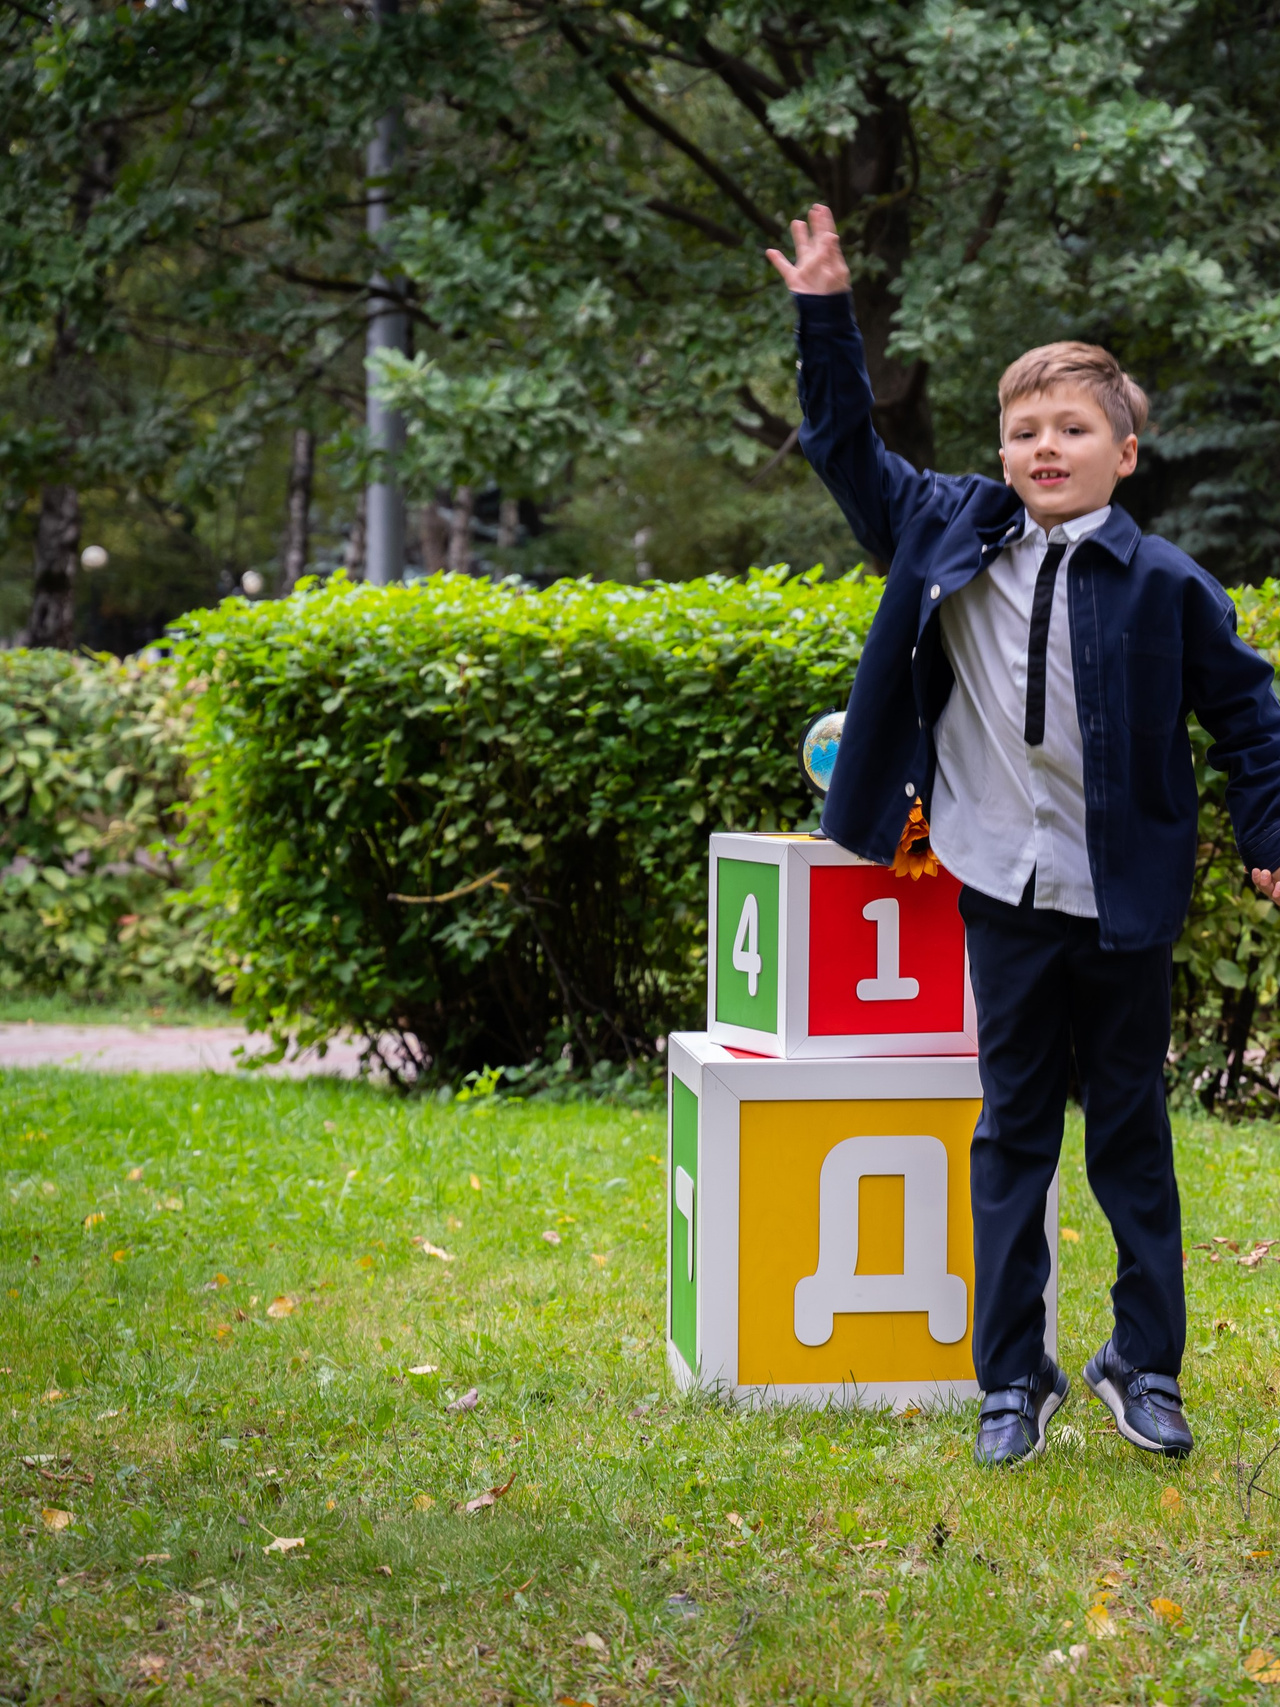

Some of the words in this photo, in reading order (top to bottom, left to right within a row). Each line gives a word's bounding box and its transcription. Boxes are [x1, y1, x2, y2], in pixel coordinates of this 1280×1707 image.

[732, 893, 763, 997] 4
[856, 897, 920, 1001] 1
[794, 1134, 968, 1347] Д
